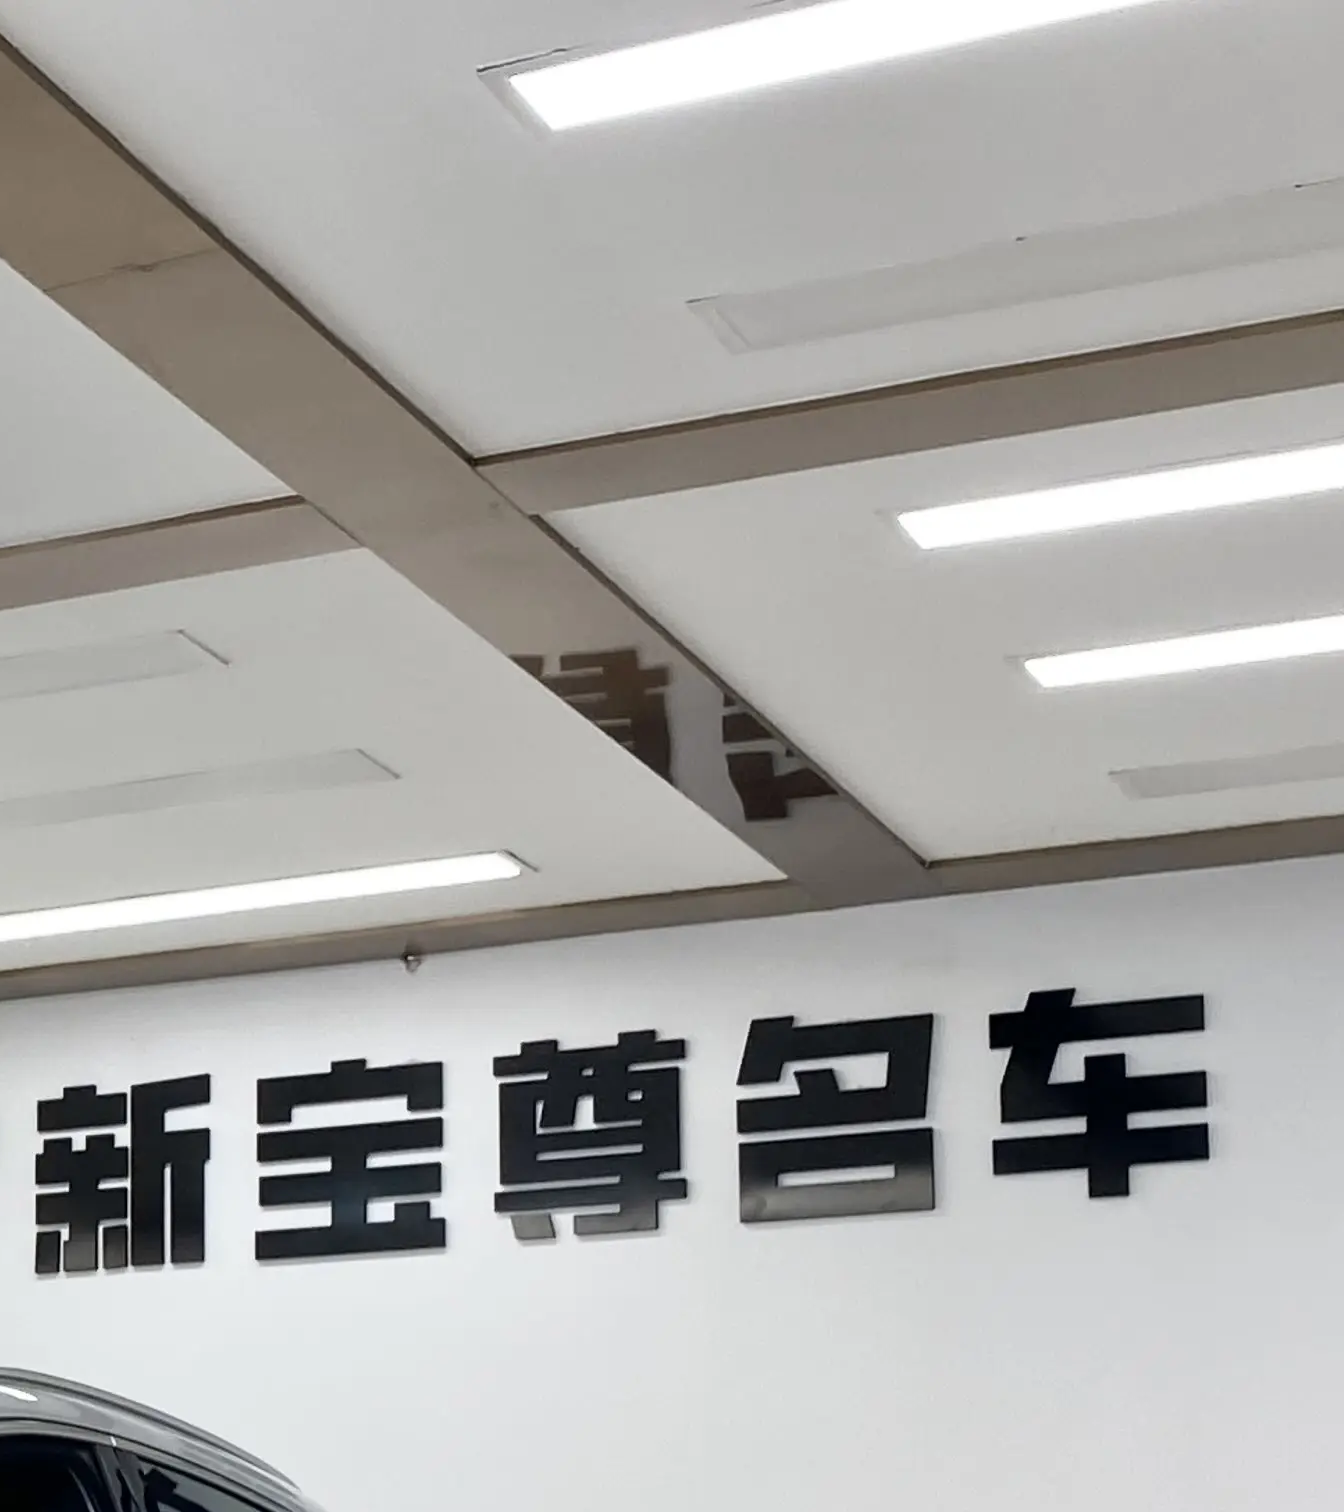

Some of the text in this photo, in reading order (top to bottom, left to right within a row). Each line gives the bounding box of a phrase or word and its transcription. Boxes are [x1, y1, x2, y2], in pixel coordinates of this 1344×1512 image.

[34, 987, 1210, 1274] 新宝尊名车
